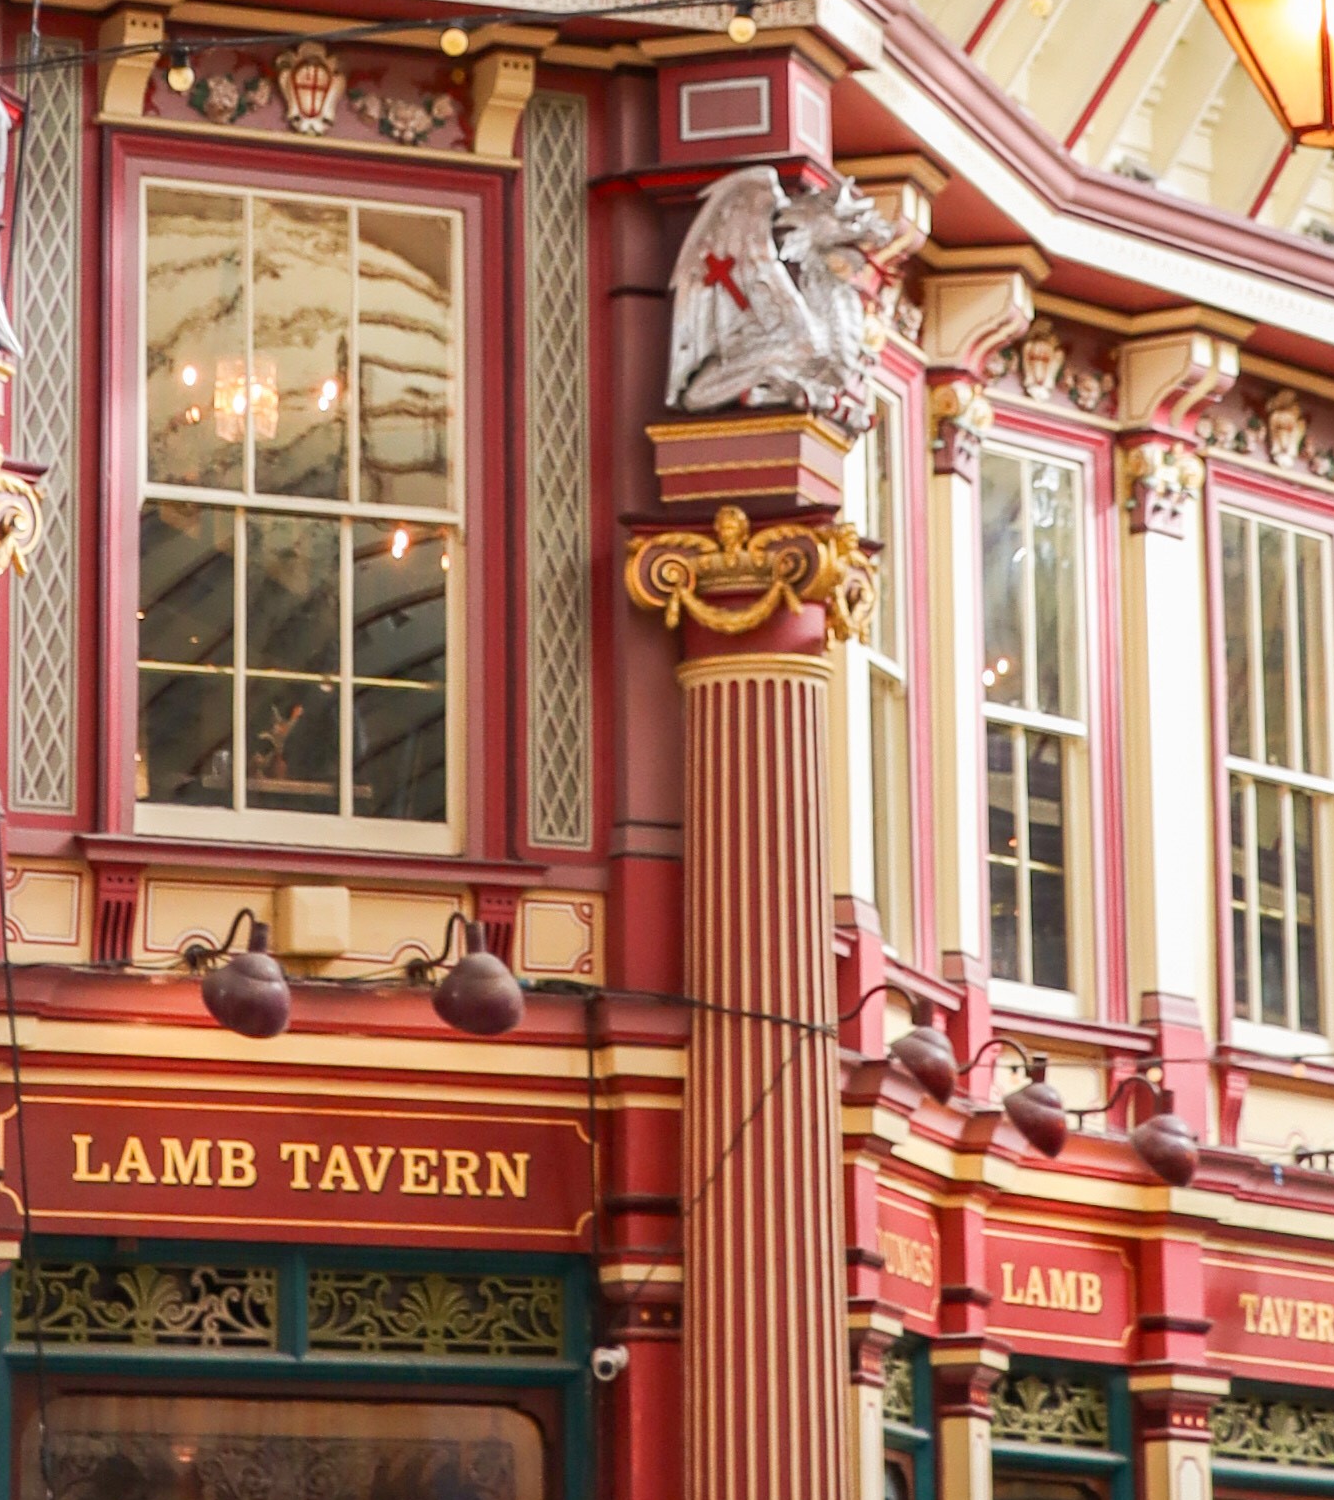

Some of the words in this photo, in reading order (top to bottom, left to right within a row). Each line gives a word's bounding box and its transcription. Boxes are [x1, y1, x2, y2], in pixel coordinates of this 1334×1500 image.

[71, 1133, 258, 1188] LAMB
[280, 1142, 531, 1198] TAVERN
[877, 1227, 934, 1287] UNGS
[1000, 1261, 1103, 1315] LAMB
